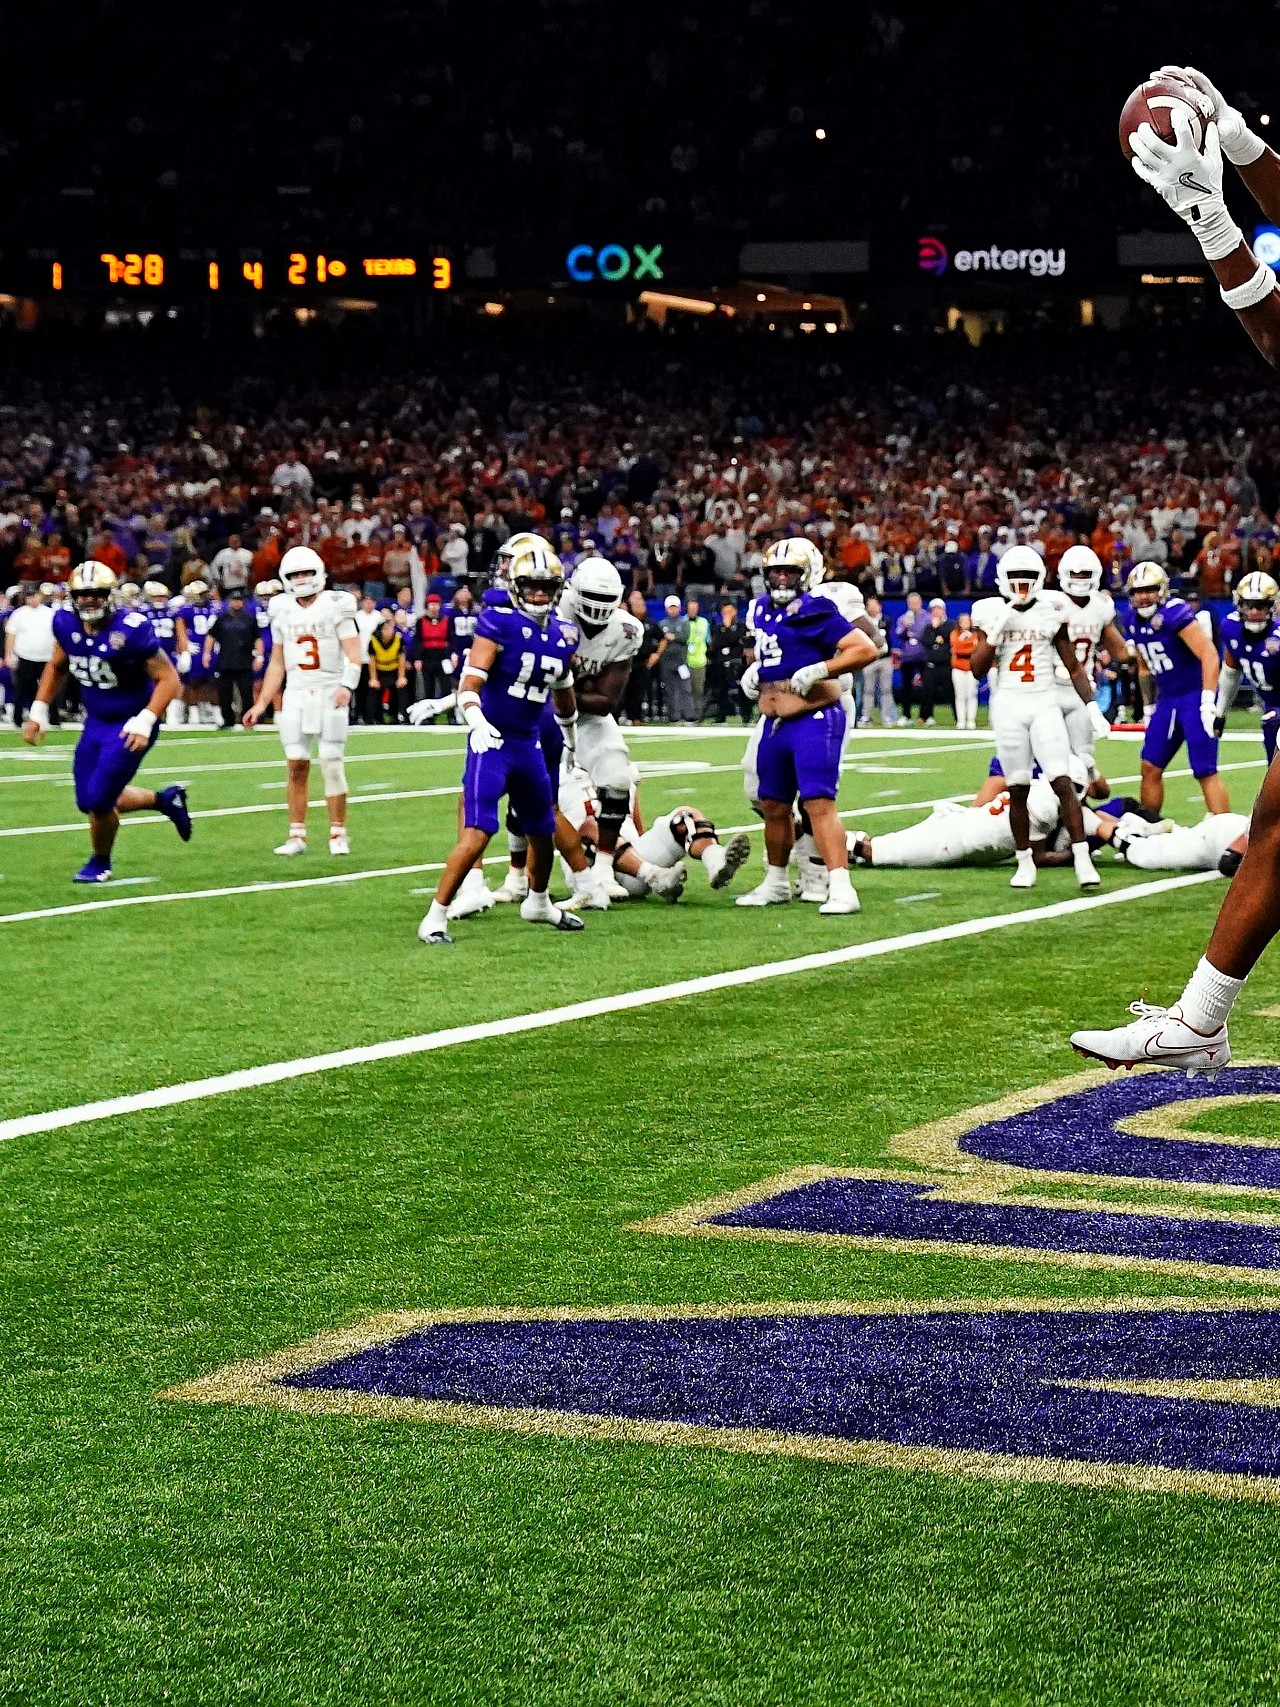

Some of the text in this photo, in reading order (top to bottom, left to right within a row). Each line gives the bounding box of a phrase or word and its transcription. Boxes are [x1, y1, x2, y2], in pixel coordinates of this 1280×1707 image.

[52, 262, 62, 290] 1
[101, 253, 164, 285] 7:28
[209, 261, 263, 290] 1 4
[363, 258, 417, 276] TEXAS
[433, 257, 451, 289] 3
[566, 243, 664, 281] COX
[954, 244, 1066, 277] entergy
[297, 635, 320, 670] 3
[1009, 644, 1034, 682] 4
[507, 651, 563, 703] 13
[1240, 658, 1273, 691] 11
